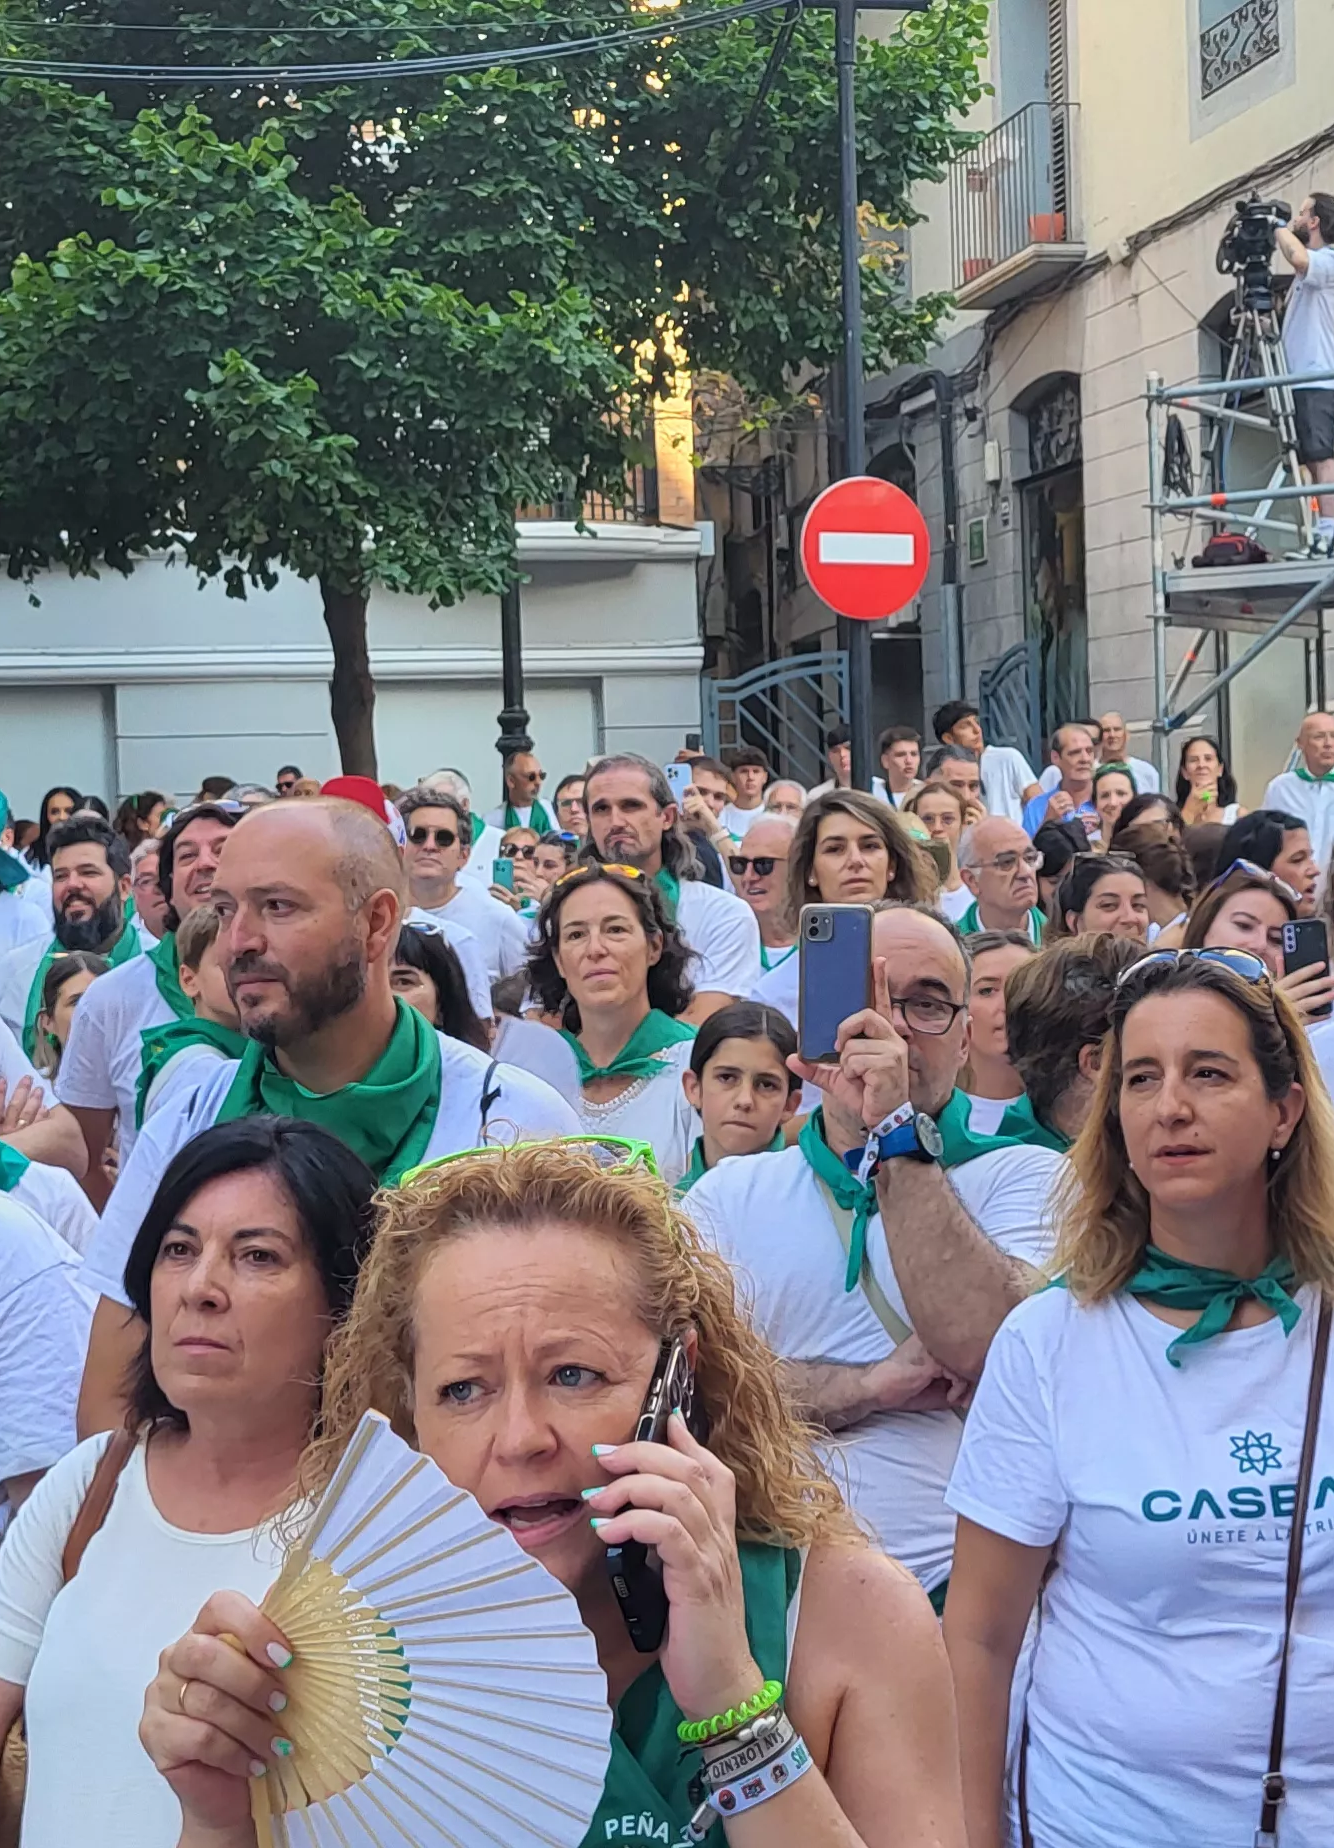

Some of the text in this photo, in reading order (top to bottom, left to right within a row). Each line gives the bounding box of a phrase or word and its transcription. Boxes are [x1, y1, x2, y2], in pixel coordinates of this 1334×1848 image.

[1187, 1528, 1247, 1545] ÚNETE
[1255, 1530, 1267, 1542] A
[712, 1727, 785, 1779] SAN LORENZO
[604, 1811, 669, 1844] PEÑA
